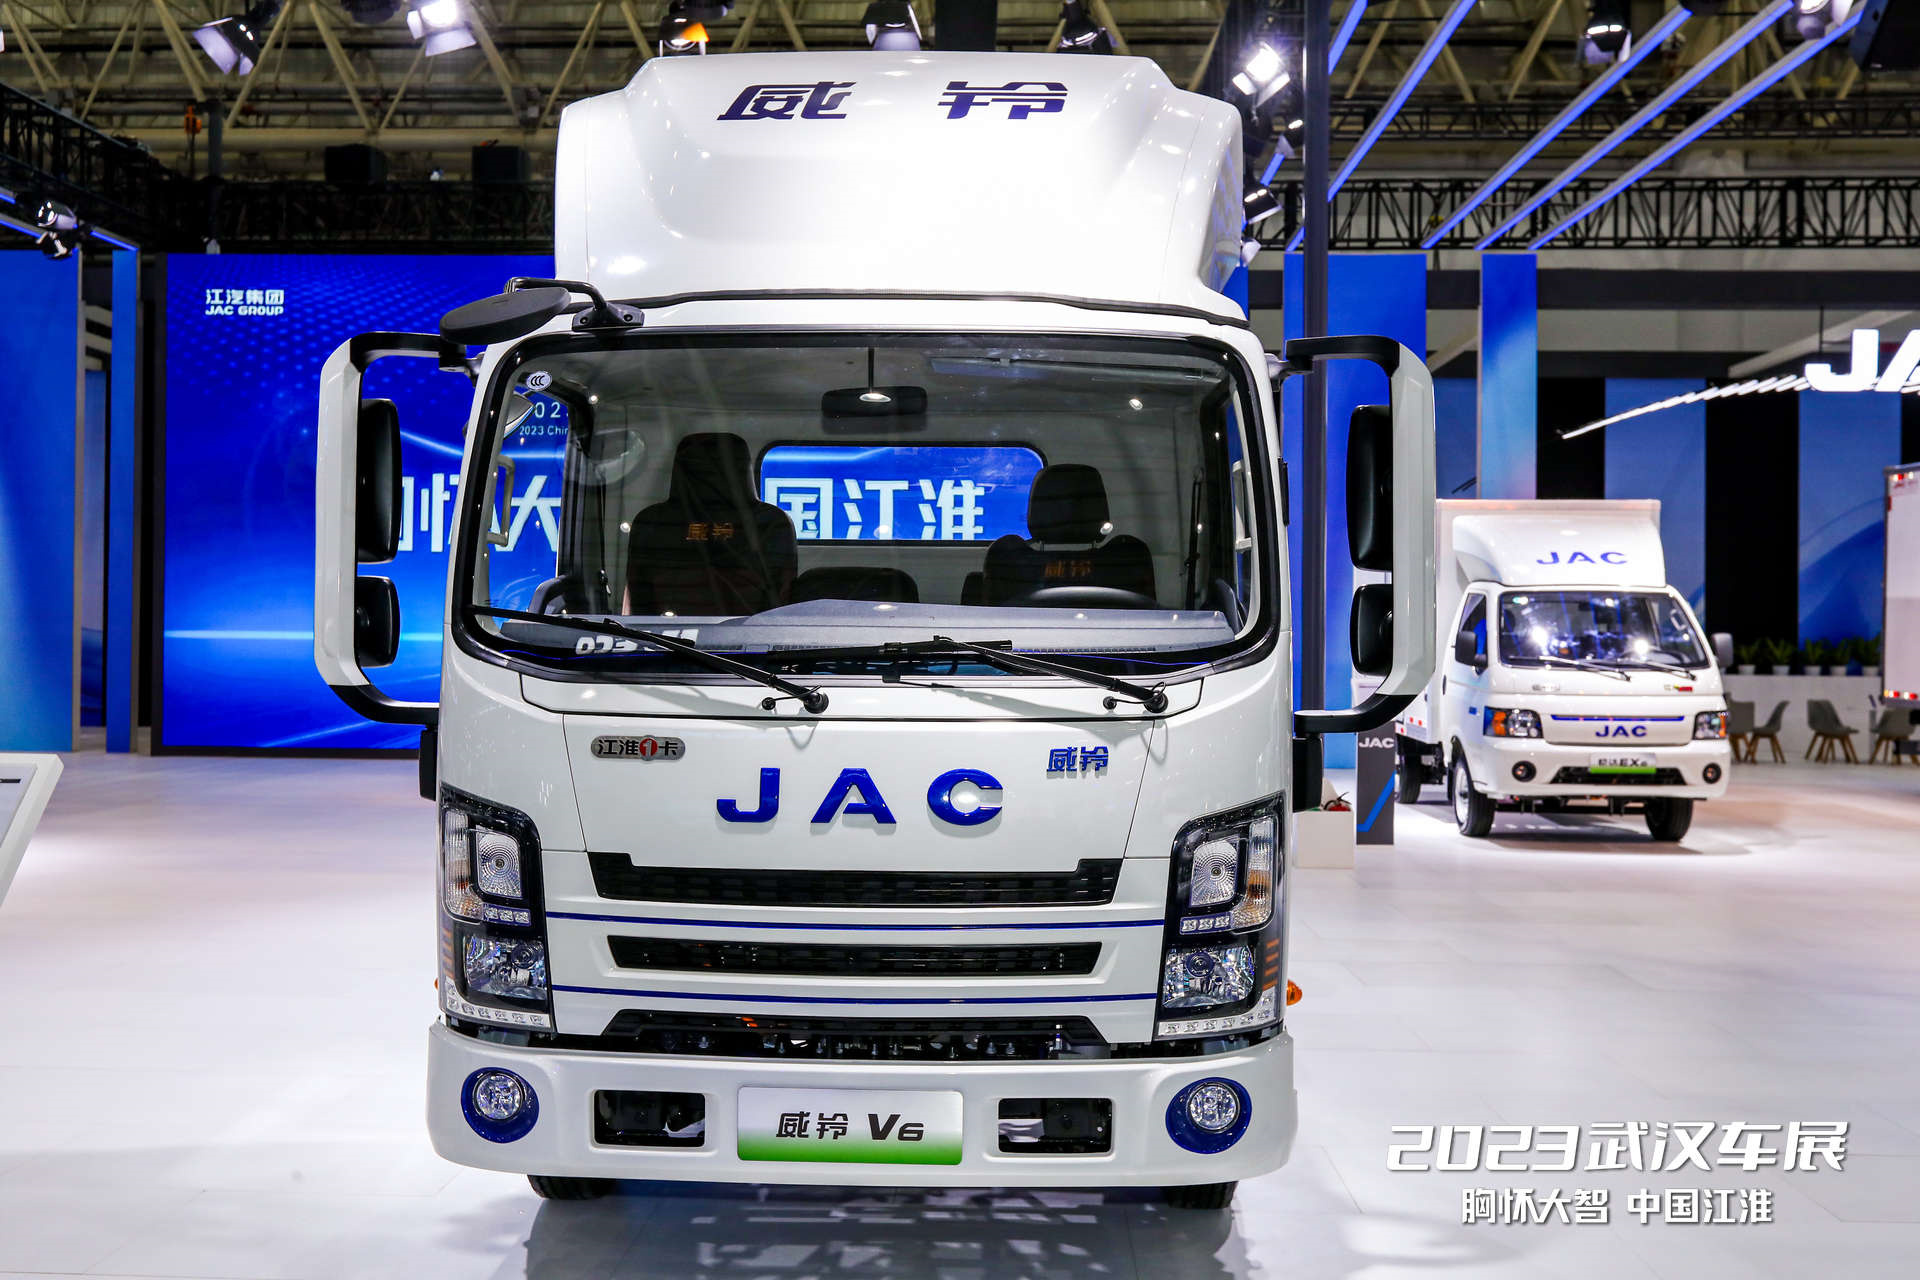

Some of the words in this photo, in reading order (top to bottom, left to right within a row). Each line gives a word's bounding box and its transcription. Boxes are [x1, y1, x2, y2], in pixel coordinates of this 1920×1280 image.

[717, 81, 1068, 120] 威铃
[205, 288, 285, 305] 江汽集团
[205, 305, 234, 316] JAC
[237, 305, 284, 316] GROUP
[519, 425, 545, 436] 2023
[1536, 551, 1628, 565] JAC
[1595, 725, 1647, 737] JAC
[1358, 737, 1395, 748] JAC
[1046, 746, 1109, 772] 威铃
[716, 767, 1004, 827] JAC
[775, 1111, 849, 1140] 威铃
[867, 1113, 925, 1142] V6
